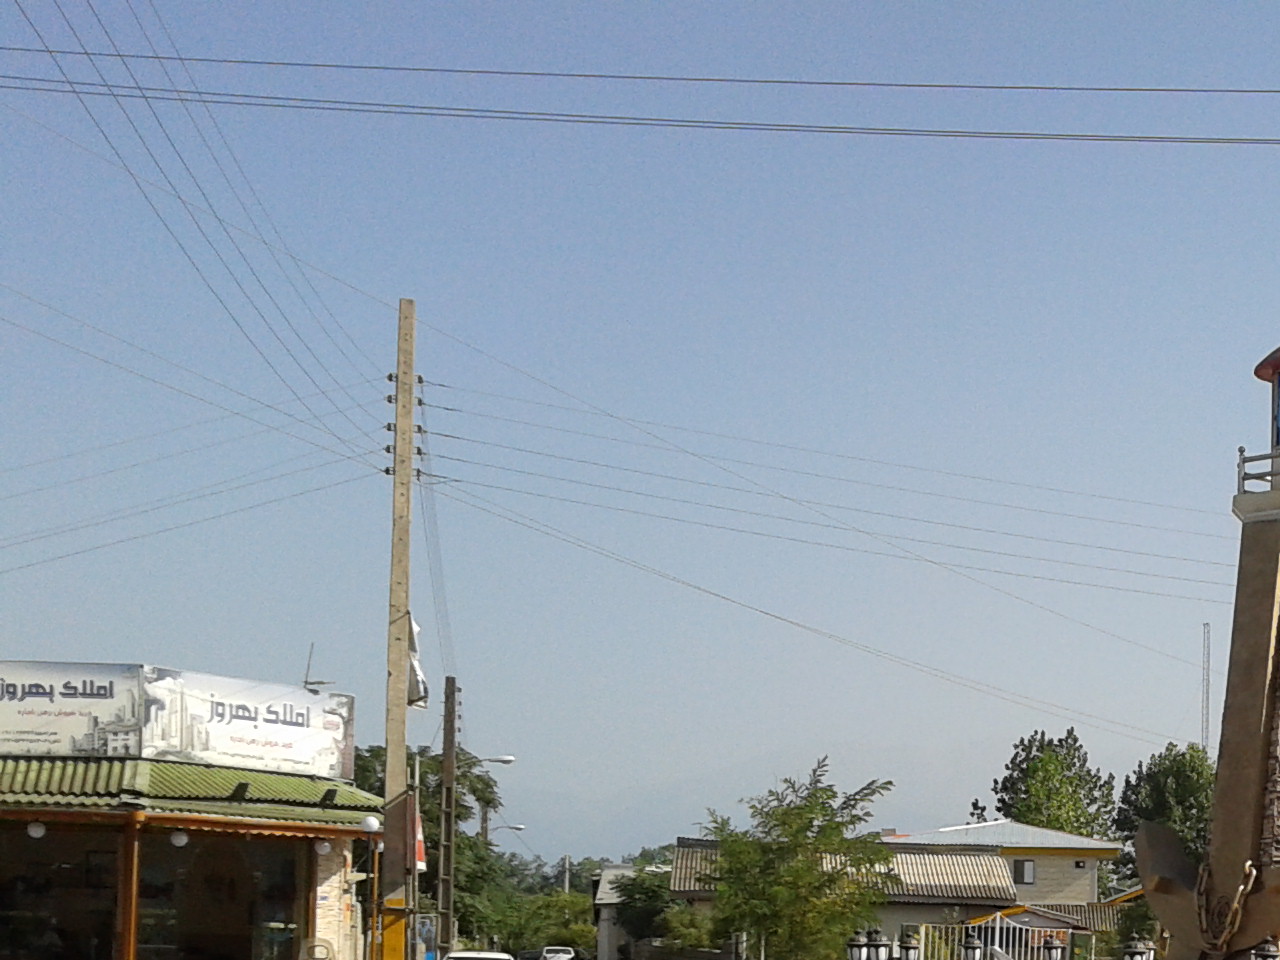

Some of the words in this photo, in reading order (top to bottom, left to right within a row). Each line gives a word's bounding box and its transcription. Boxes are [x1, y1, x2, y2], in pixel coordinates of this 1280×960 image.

[59, 679, 114, 699] املاک
[207, 692, 259, 729] بهروز
[262, 702, 311, 728] املاک
